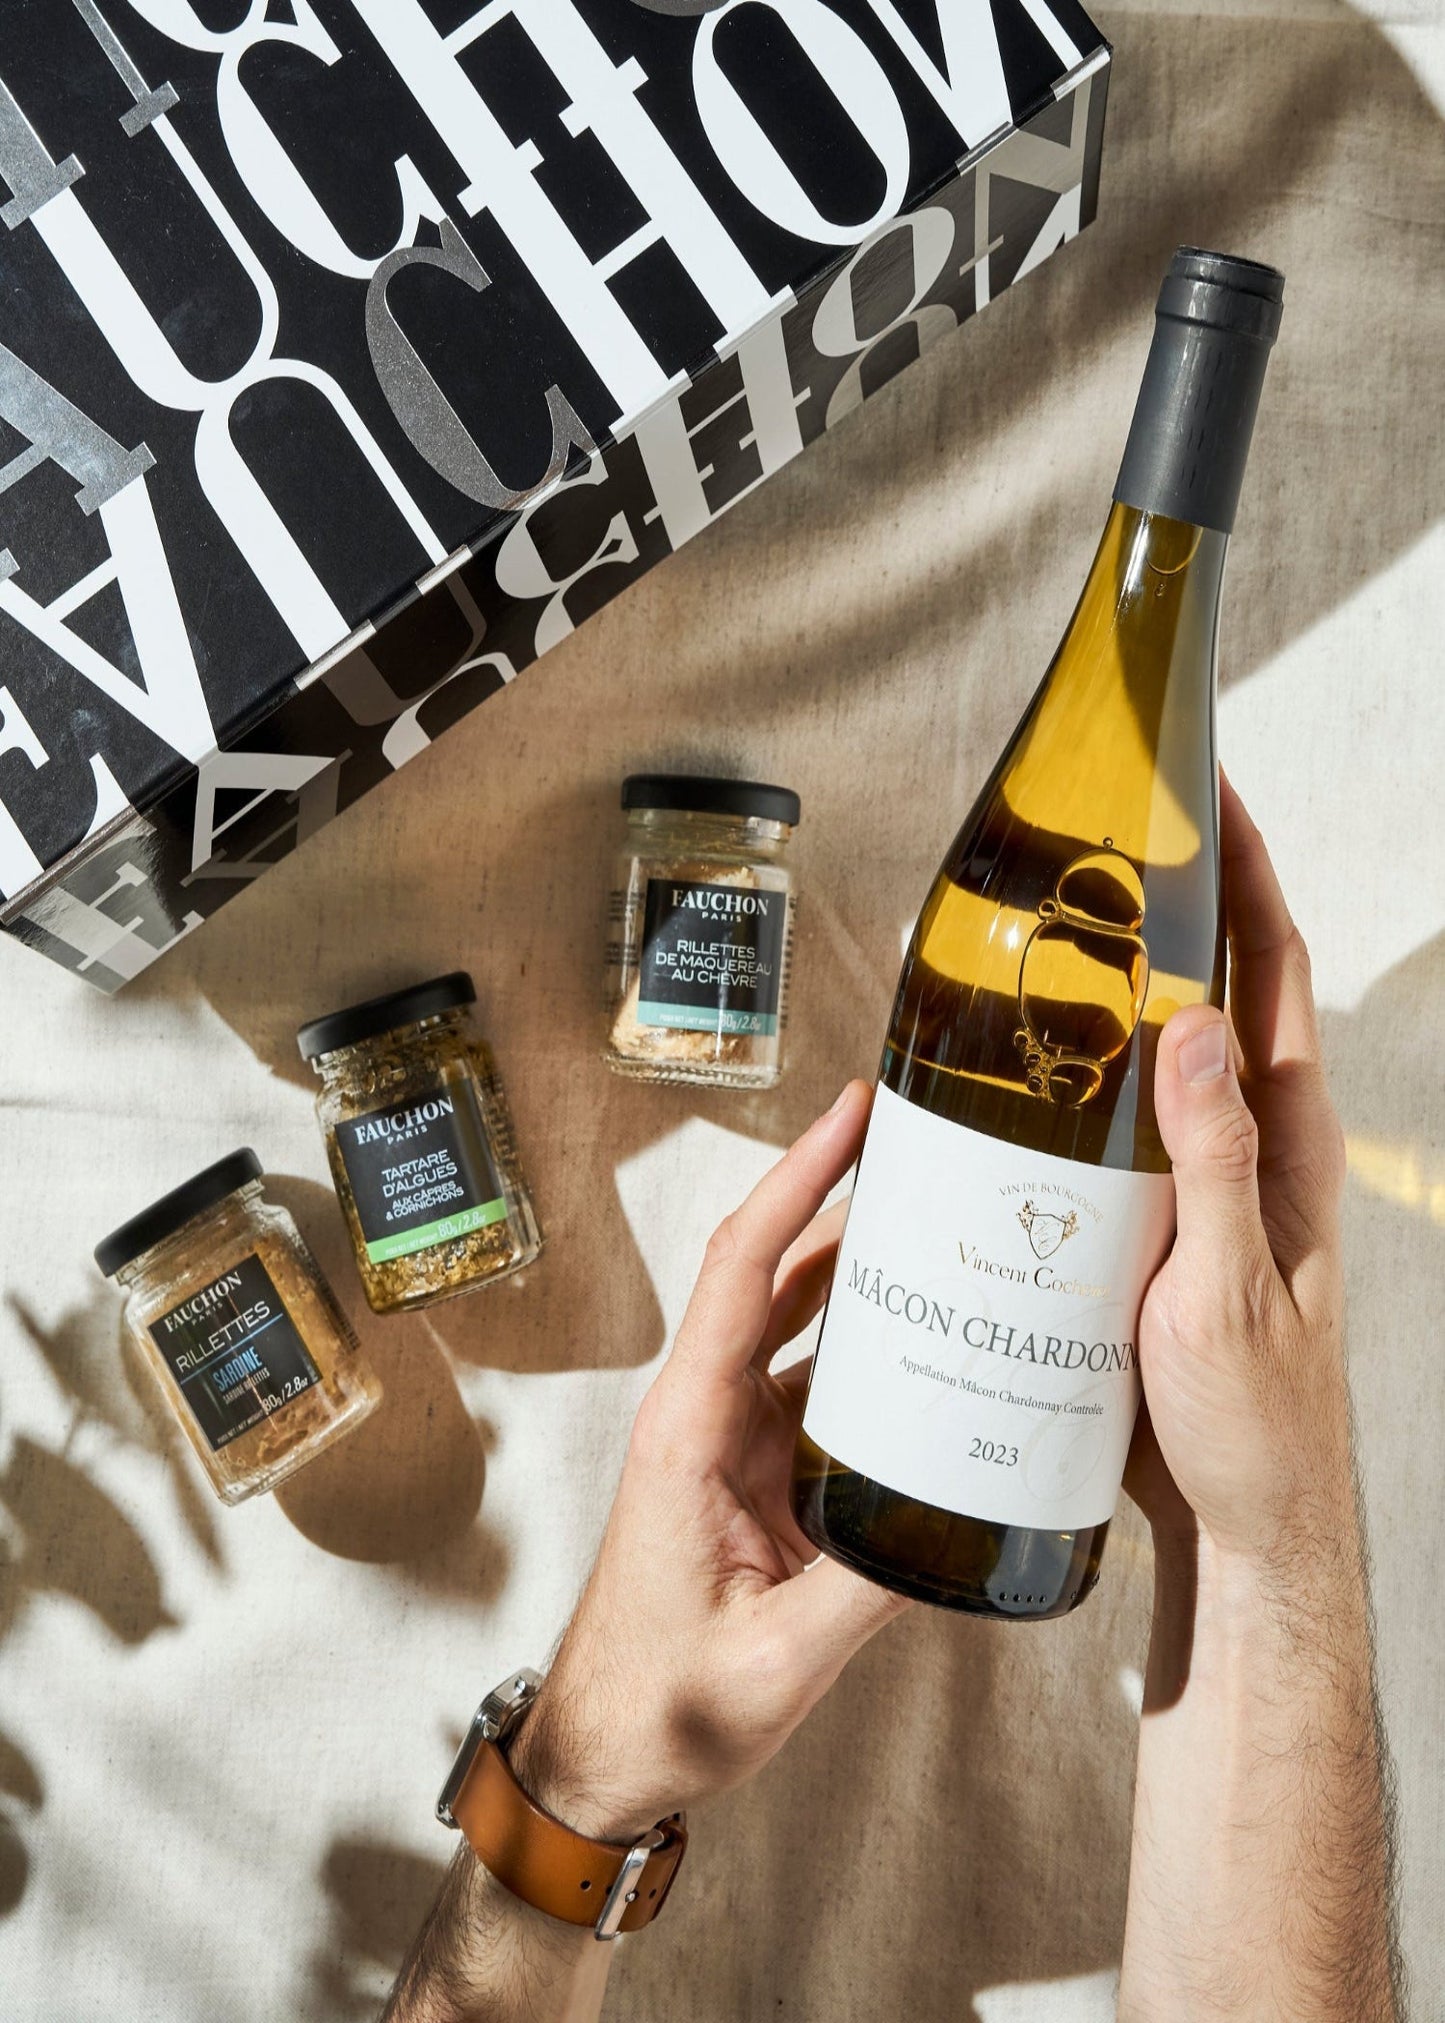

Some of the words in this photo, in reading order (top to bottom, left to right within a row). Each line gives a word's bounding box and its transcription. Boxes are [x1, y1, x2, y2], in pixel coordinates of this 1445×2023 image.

[672, 889, 768, 916] FAUCHON
[701, 911, 741, 922] PARIS
[655, 951, 678, 966] DE
[680, 955, 770, 976] MAQUEREAU
[677, 939, 755, 959] RILLETTES
[671, 967, 694, 982] AU
[697, 970, 757, 987] CHÈVRE
[354, 1096, 454, 1145] FAUCHON
[387, 1126, 427, 1145] PARIS
[382, 1149, 450, 1181] TARTARE
[392, 1195, 413, 1210] AUX
[393, 1187, 464, 1218] CORNICHONS
[999, 1183, 1020, 1196] VIN
[1022, 1182, 1038, 1193] DE
[1040, 1183, 1104, 1223] BOURGOGNE
[959, 1242, 1027, 1285] Vincent
[164, 1270, 242, 1333] FAUCHON
[191, 1302, 223, 1326] PARIS
[848, 1259, 957, 1338] MÂCON
[963, 1317, 1139, 1372] CHARDONN
[176, 1301, 271, 1373] RILLETTES
[213, 1346, 263, 1391] SARDINE
[900, 1355, 958, 1388] Appellation
[959, 1379, 996, 1400] Mâcon
[999, 1391, 1063, 1416] Chardonnay
[969, 1438, 1019, 1467] 2023
